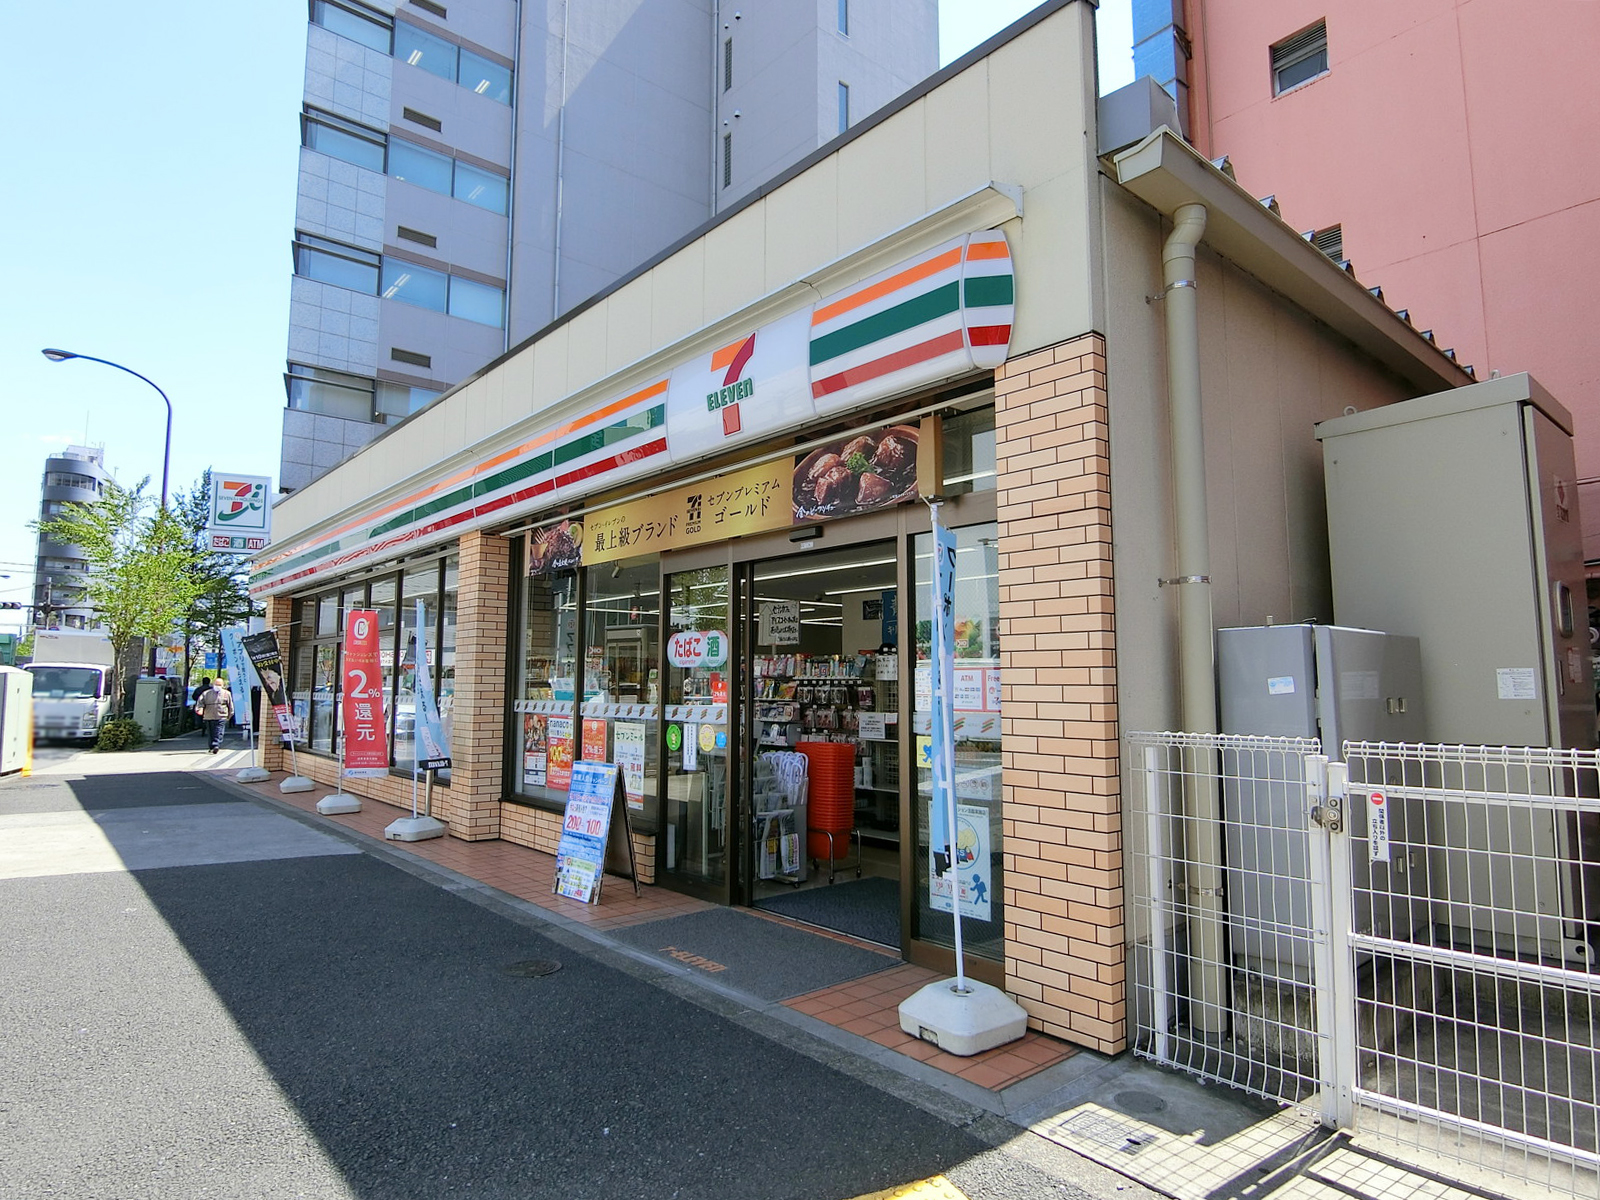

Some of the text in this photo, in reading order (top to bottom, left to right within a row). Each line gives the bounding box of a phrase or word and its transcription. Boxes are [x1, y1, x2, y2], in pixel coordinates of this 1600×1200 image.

[710, 332, 755, 436] 7
[708, 478, 780, 506] セブンプレミアム
[714, 495, 771, 524] ゴールド
[594, 514, 679, 552] 最上級ブランド
[685, 525, 702, 535] GOLD
[248, 539, 264, 549] ATM
[674, 636, 720, 658] たばこ 酒
[348, 669, 381, 699] 2%
[987, 674, 1000, 682] Free
[355, 702, 376, 741] 還元
[615, 731, 643, 742] セブンミール
[566, 814, 602, 835] 200 100
